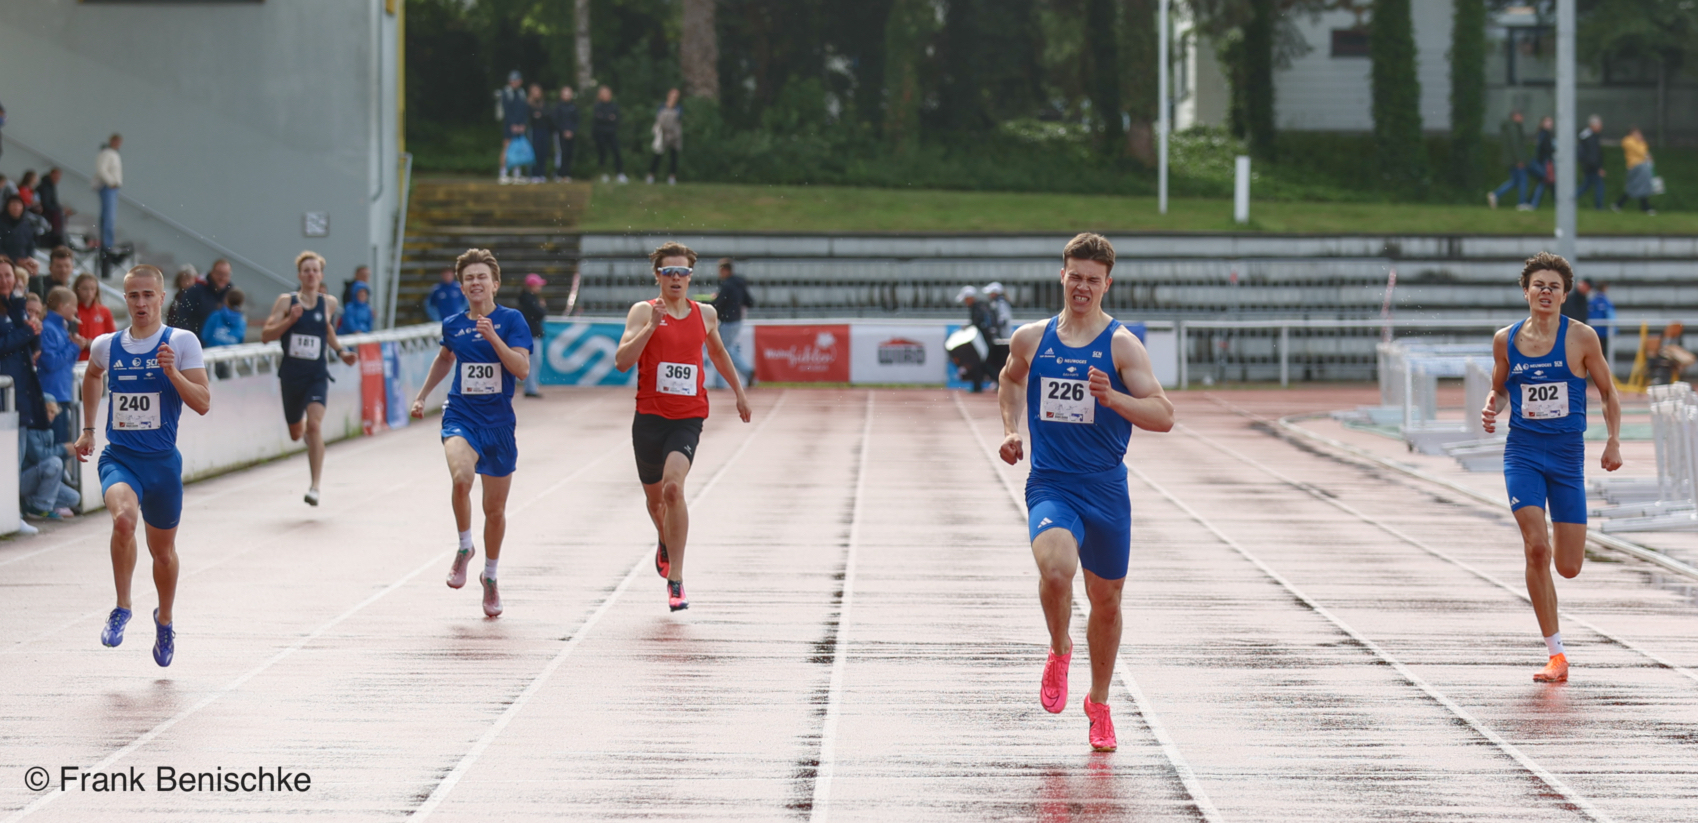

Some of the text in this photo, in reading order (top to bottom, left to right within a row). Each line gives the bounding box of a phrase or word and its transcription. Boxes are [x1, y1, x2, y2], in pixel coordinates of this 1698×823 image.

[467, 365, 494, 378] 230
[665, 365, 691, 379] 369
[1048, 381, 1084, 401] 226
[1528, 385, 1559, 402] 202
[119, 395, 150, 411] 240
